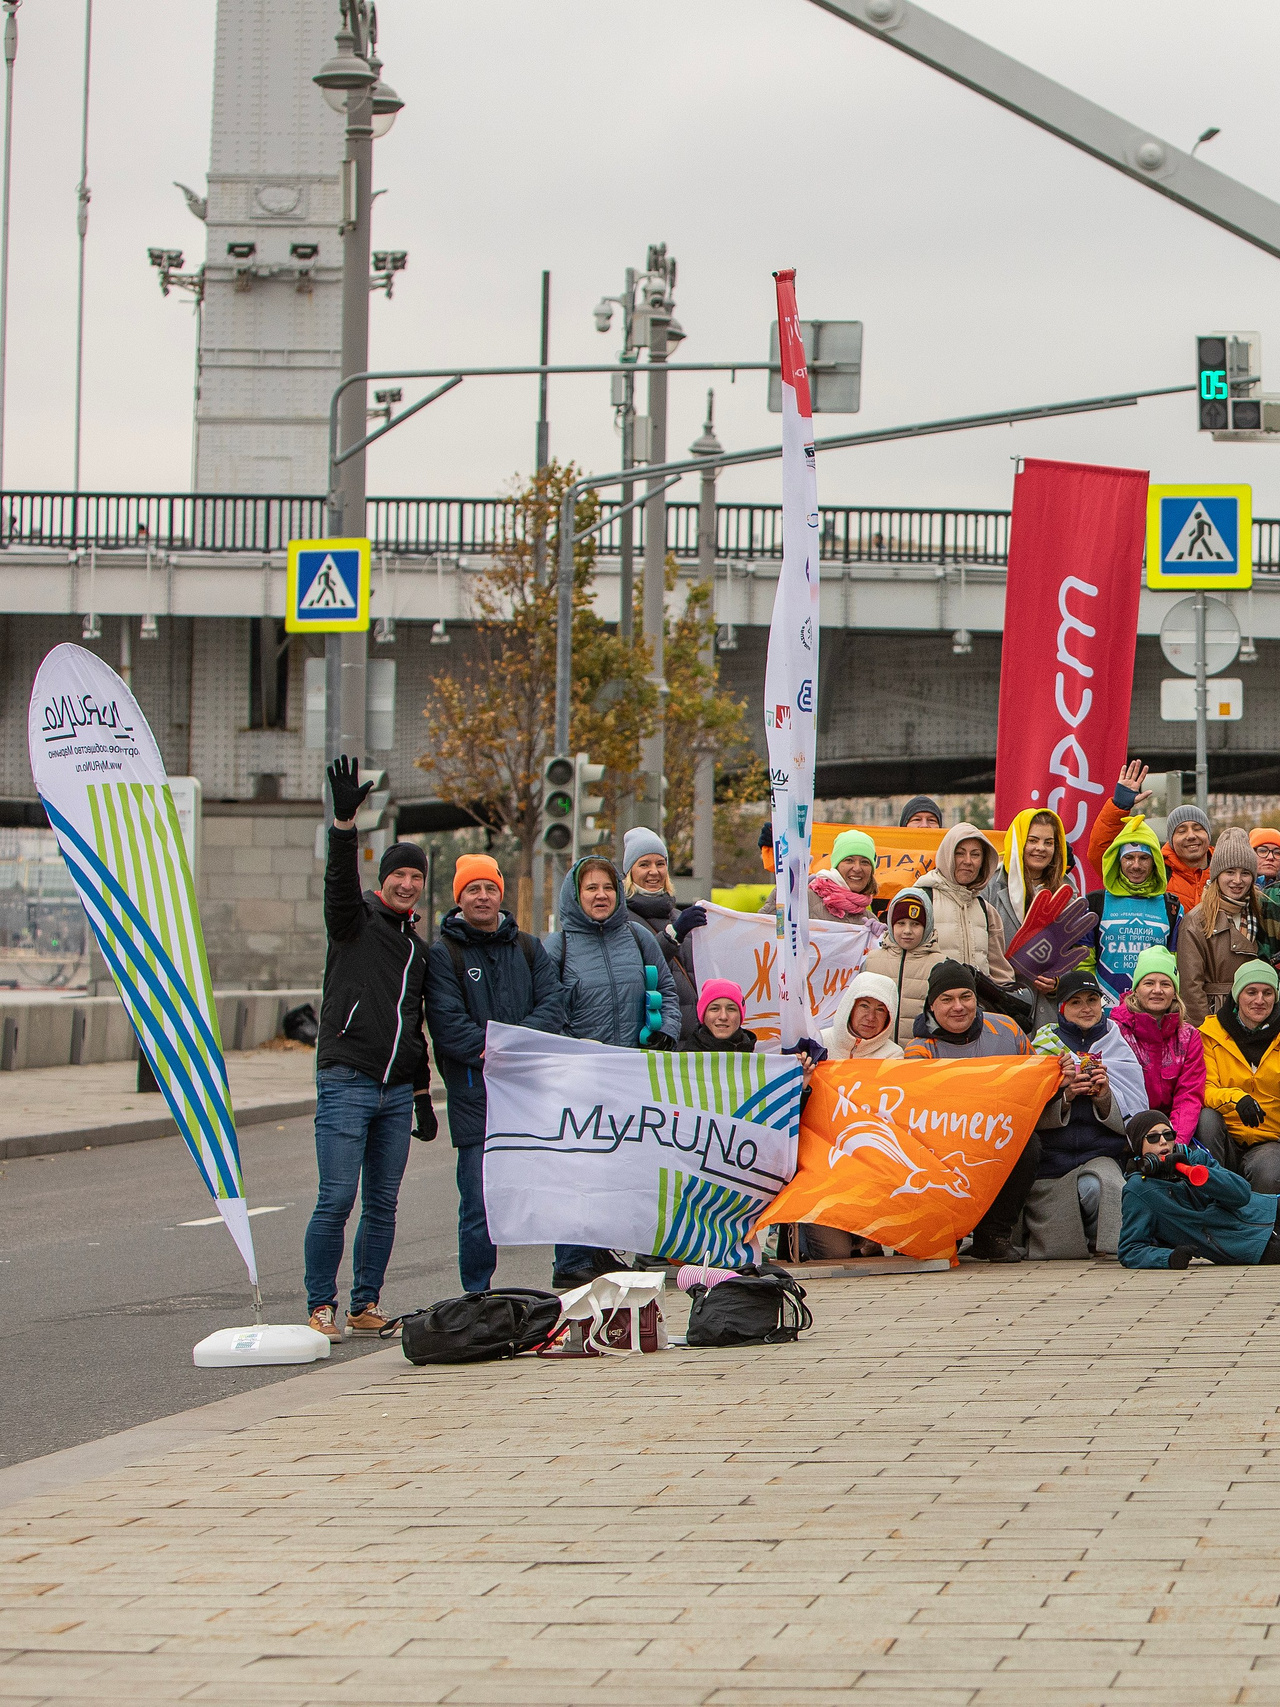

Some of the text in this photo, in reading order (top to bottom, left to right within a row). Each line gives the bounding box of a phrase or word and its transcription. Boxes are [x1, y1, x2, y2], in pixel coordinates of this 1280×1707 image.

[1201, 370, 1228, 400] 05
[1119, 927, 1154, 936] СЛАДКИЙ
[1123, 961, 1137, 969] МОЛ
[556, 1104, 758, 1170] MyRUNo
